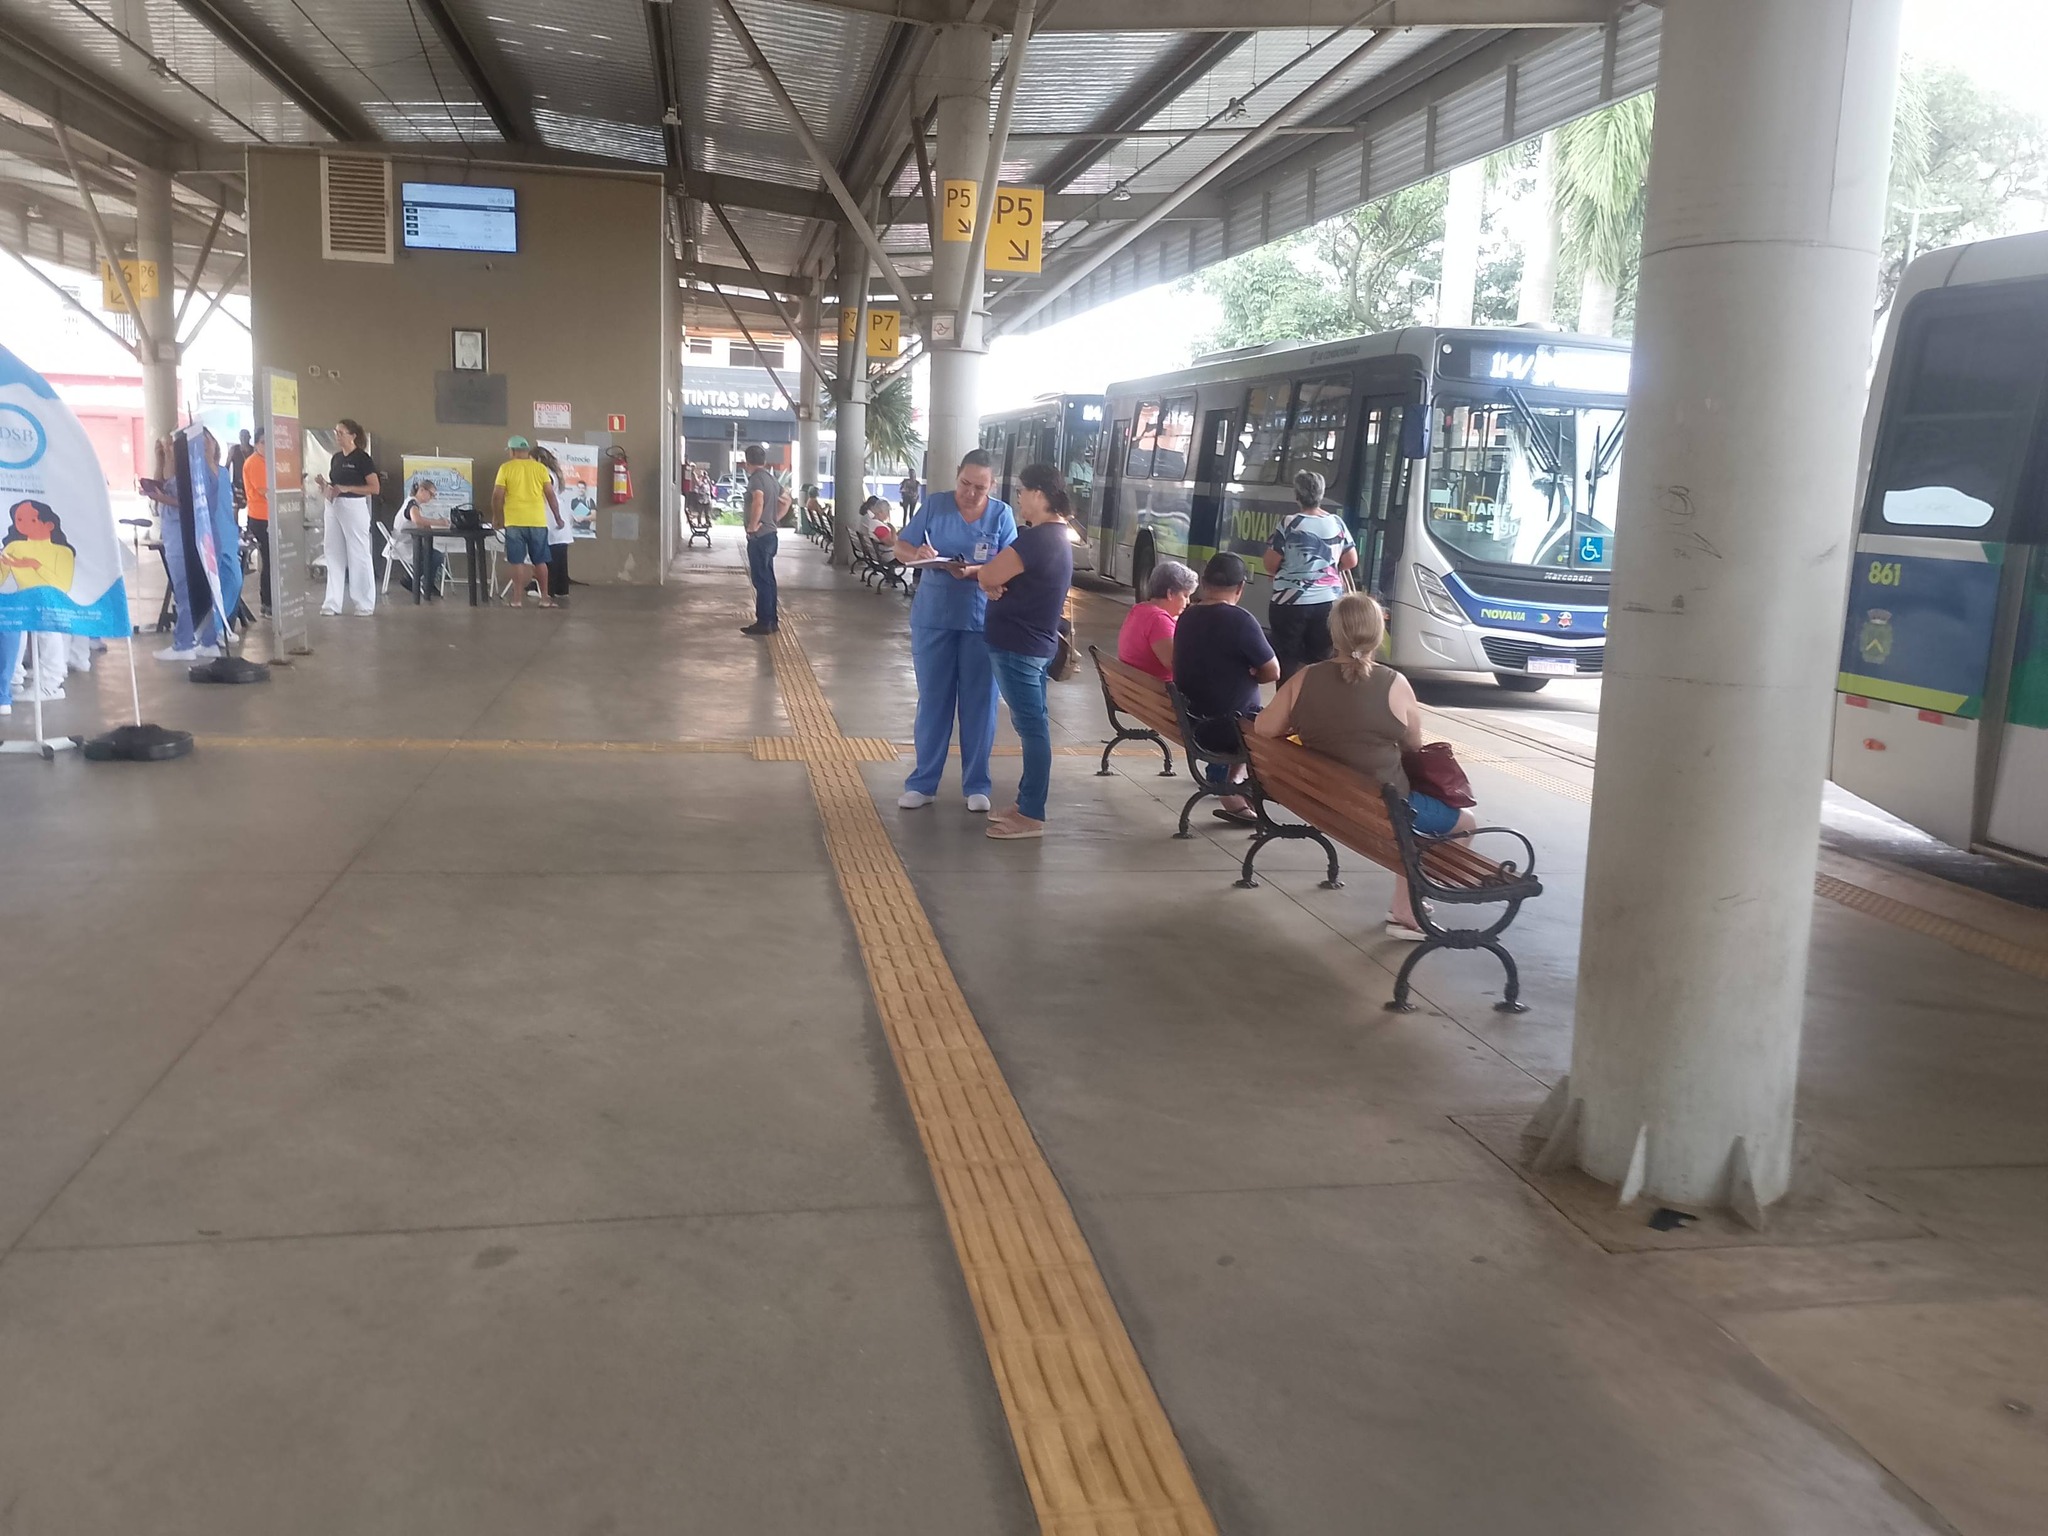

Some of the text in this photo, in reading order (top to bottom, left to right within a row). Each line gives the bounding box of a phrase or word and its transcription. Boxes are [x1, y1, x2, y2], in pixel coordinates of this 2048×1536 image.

[946, 188, 971, 208] P5
[996, 195, 1033, 227] P5
[140, 264, 156, 278] P6
[843, 311, 857, 323] P7
[872, 314, 895, 332] P7
[536, 403, 570, 412] PROIBIDO
[681, 388, 770, 410] TINTAS MC
[1544, 571, 1593, 583] Marcopolo
[1868, 560, 1902, 586] 861
